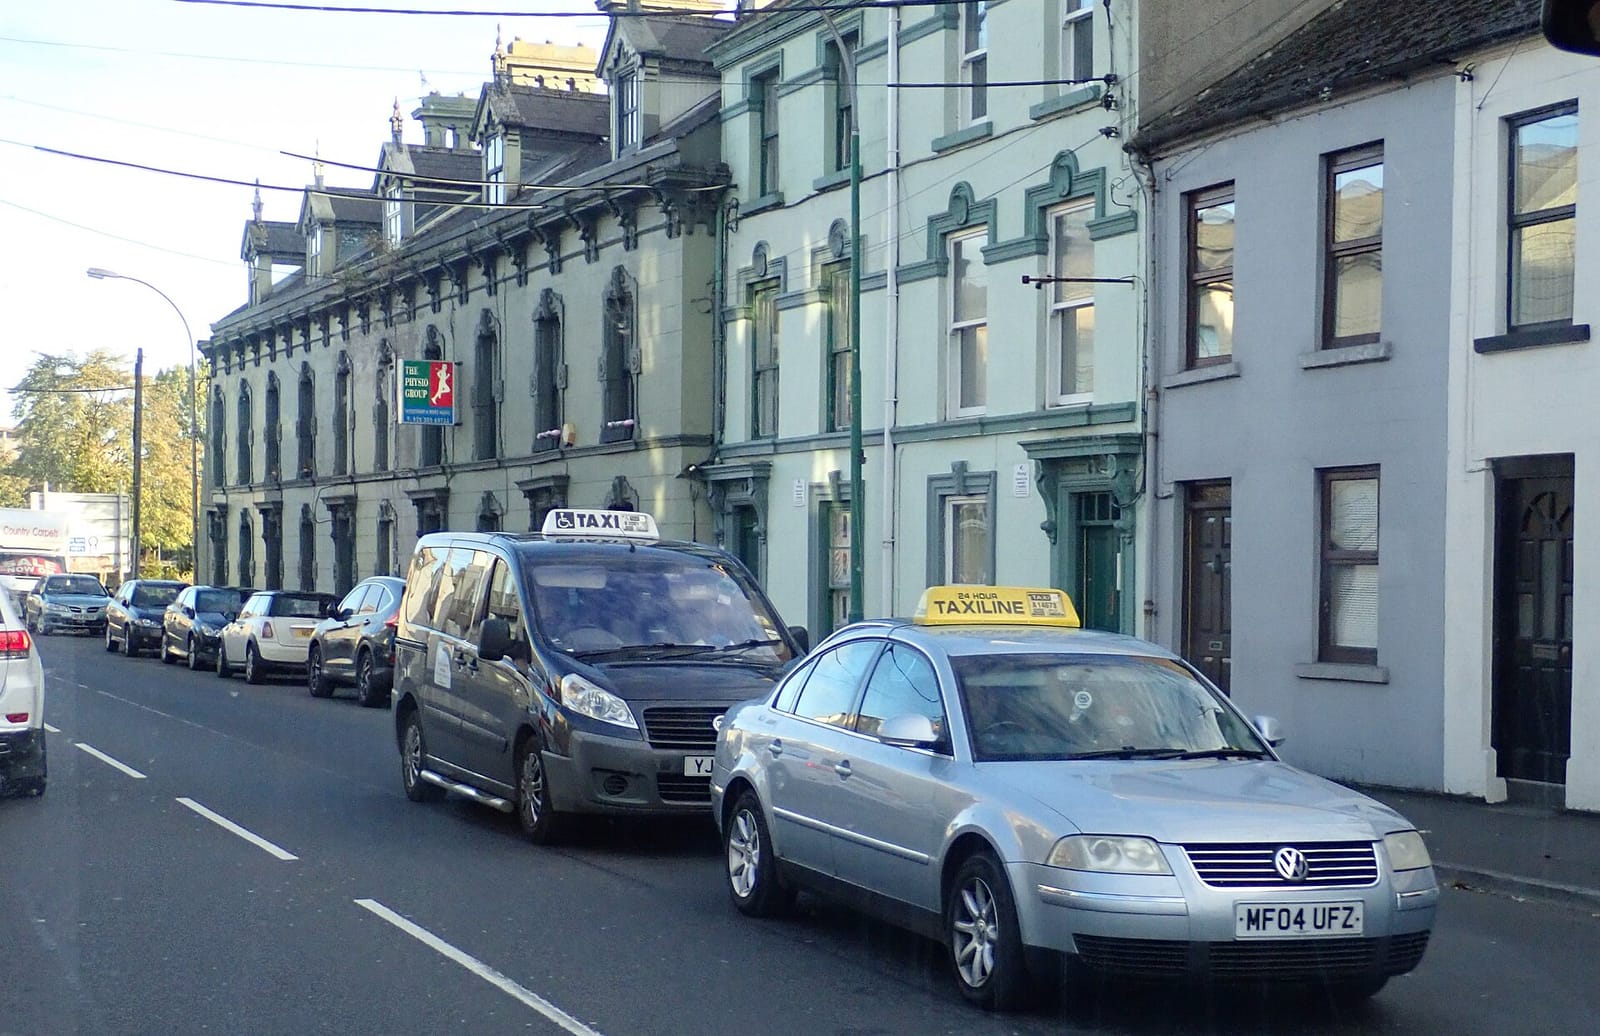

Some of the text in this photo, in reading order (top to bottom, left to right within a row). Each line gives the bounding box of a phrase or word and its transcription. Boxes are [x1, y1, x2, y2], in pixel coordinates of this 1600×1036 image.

[405, 366, 417, 374] THE
[405, 377, 429, 387] PHYSIO
[405, 389, 428, 399] GROUP
[576, 513, 620, 528] TAXI
[3, 525, 30, 536] Country
[958, 592, 998, 600] 24 HOUR
[934, 600, 1025, 615] TAXILINE
[1246, 906, 1354, 931] MF04 UFZ
